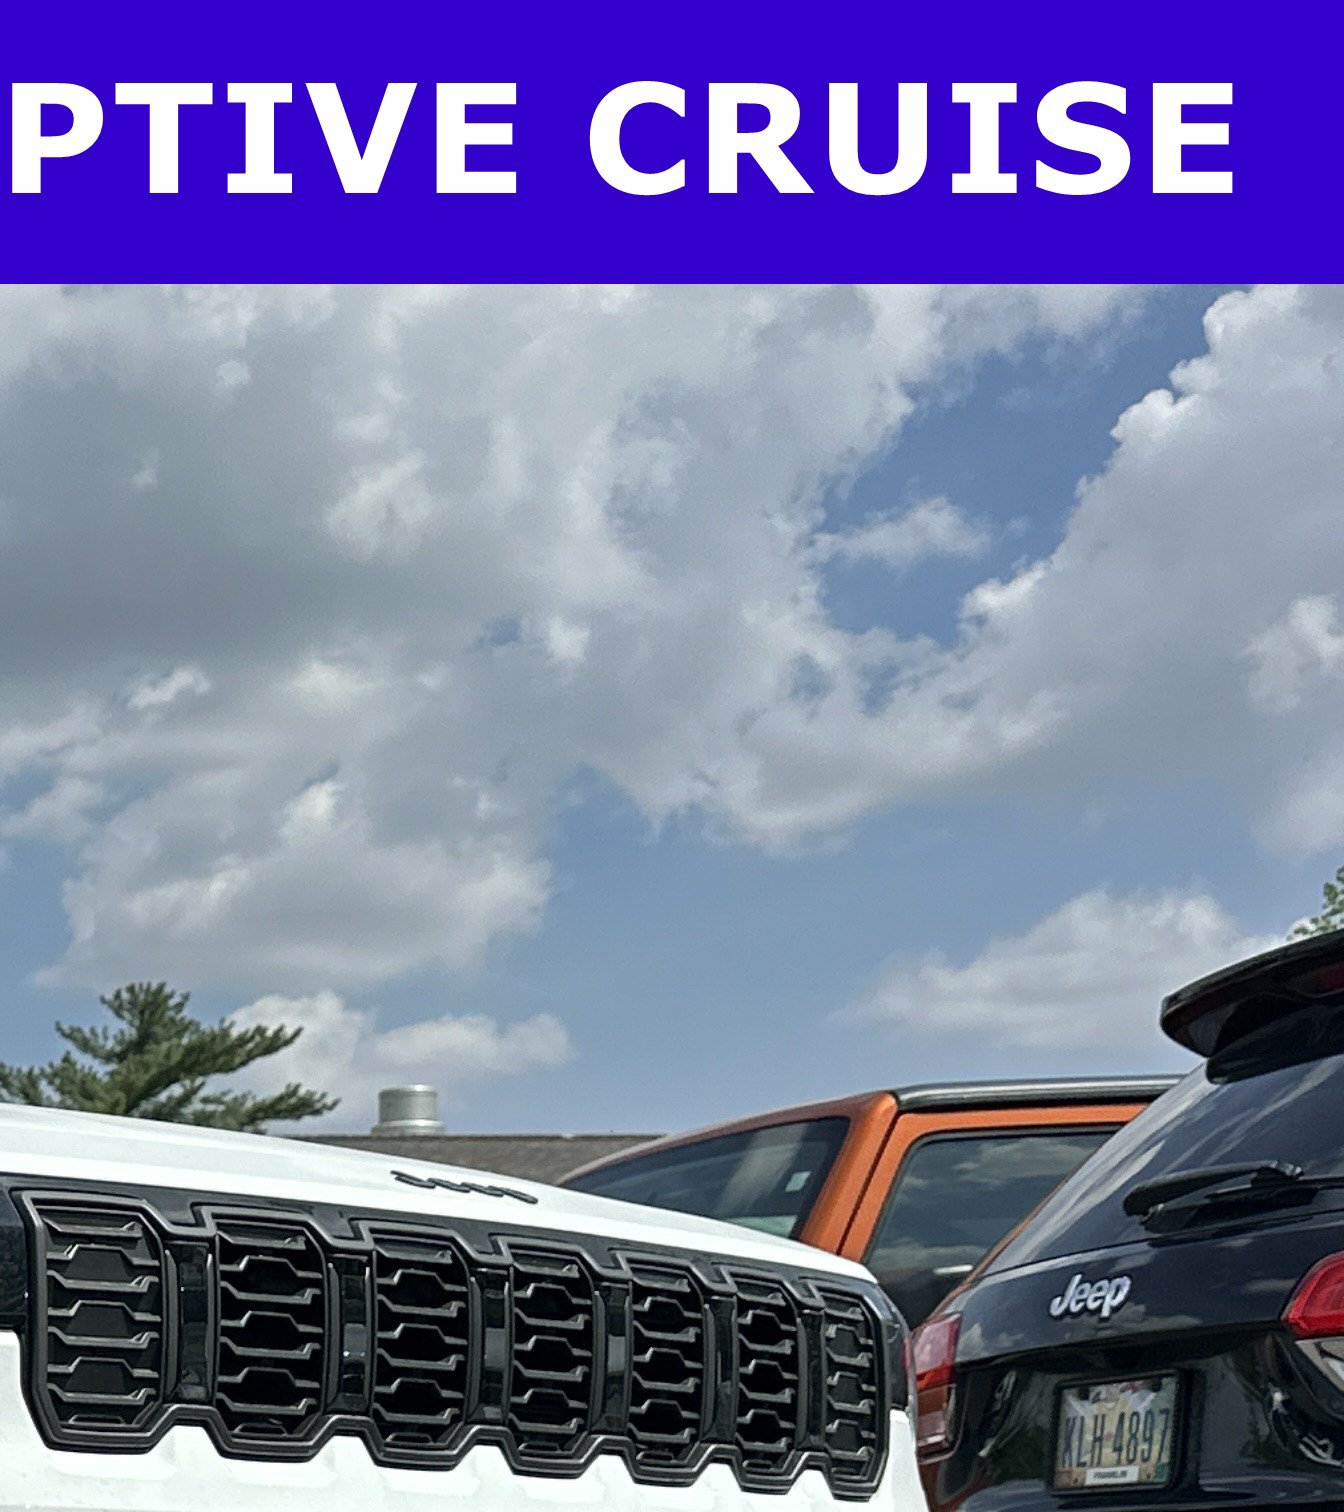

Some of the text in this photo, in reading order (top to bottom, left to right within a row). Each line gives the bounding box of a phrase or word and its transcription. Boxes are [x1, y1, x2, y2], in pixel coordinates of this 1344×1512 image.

[1049, 1273, 1132, 1318] Jeep
[1061, 1407, 1172, 1469] KLH 4897
